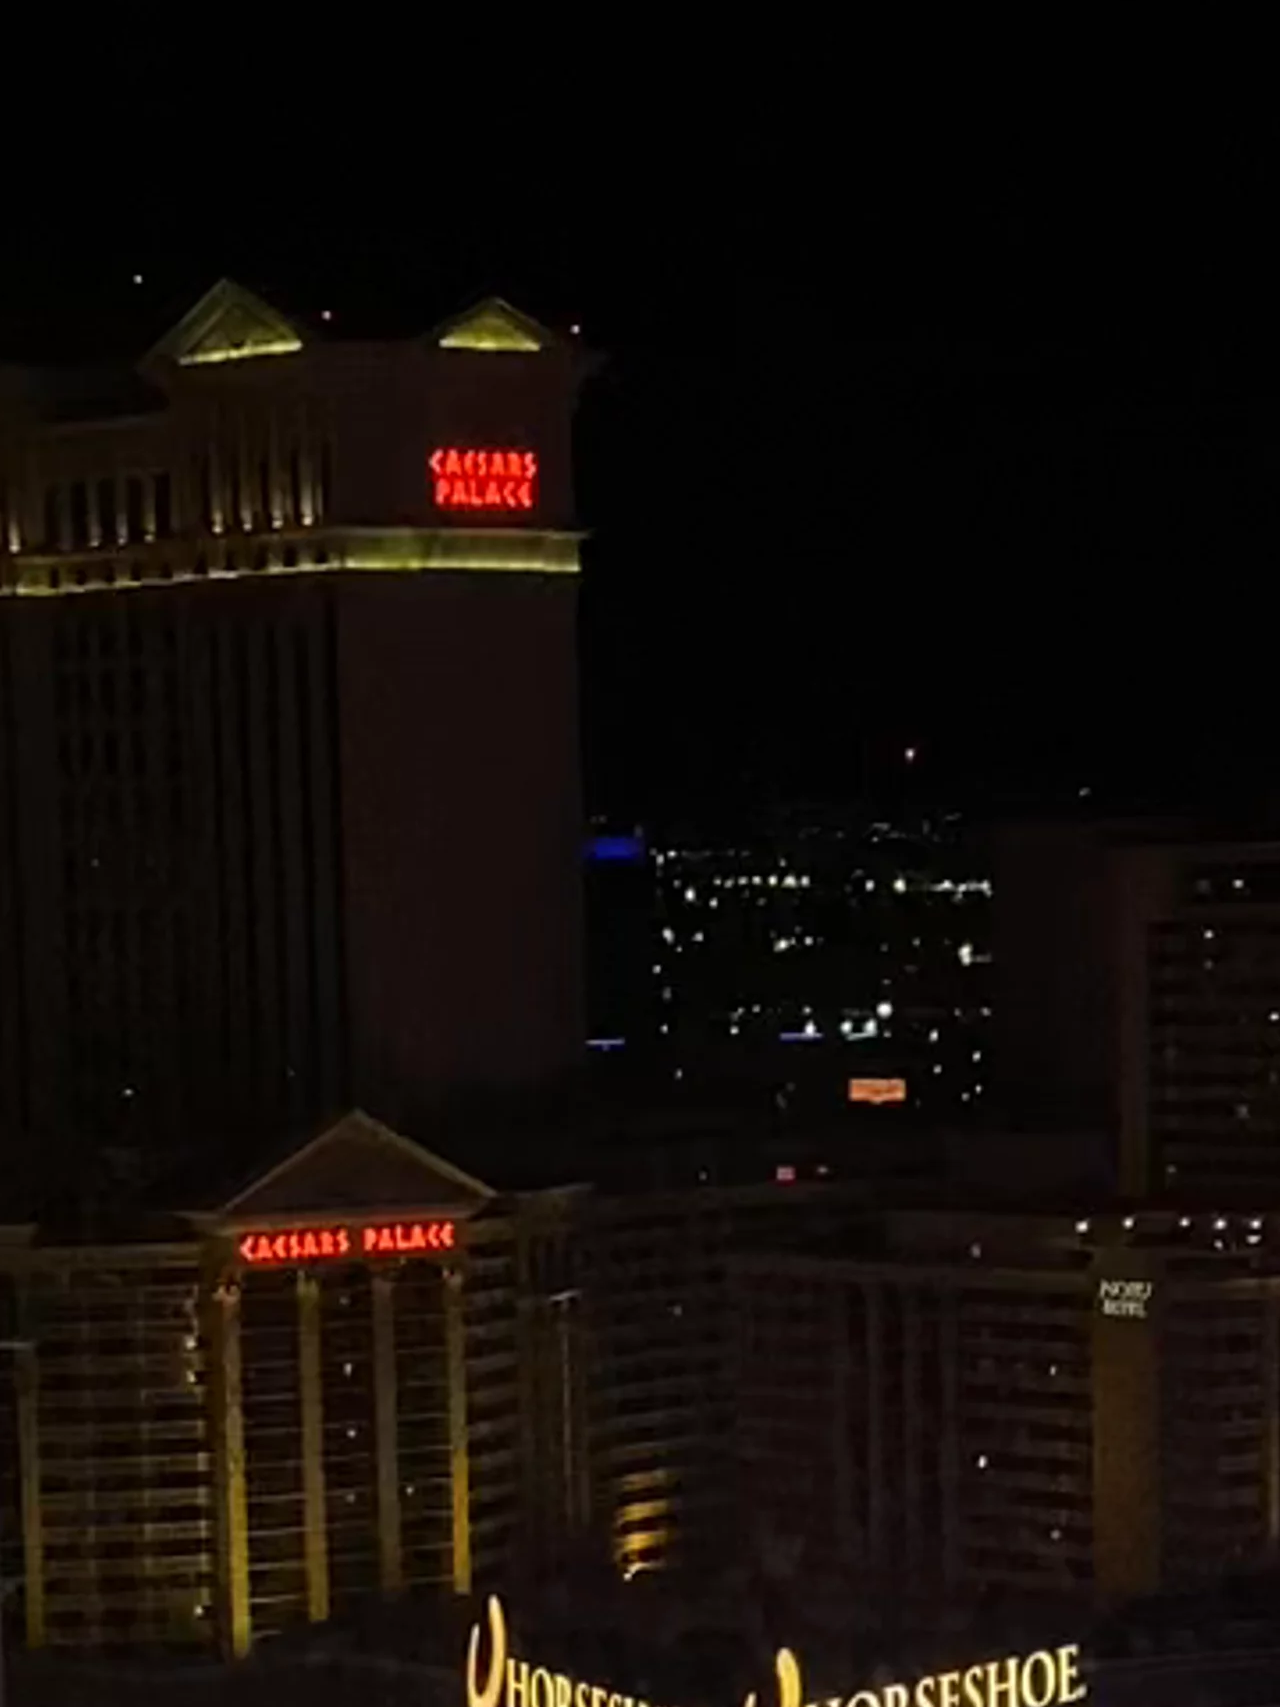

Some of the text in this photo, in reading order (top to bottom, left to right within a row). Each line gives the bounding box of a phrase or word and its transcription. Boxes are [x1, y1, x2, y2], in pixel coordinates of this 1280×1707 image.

[428, 448, 537, 479] CAESARS
[435, 477, 533, 508] PALACE
[239, 1220, 455, 1262] CAESARS PALACE
